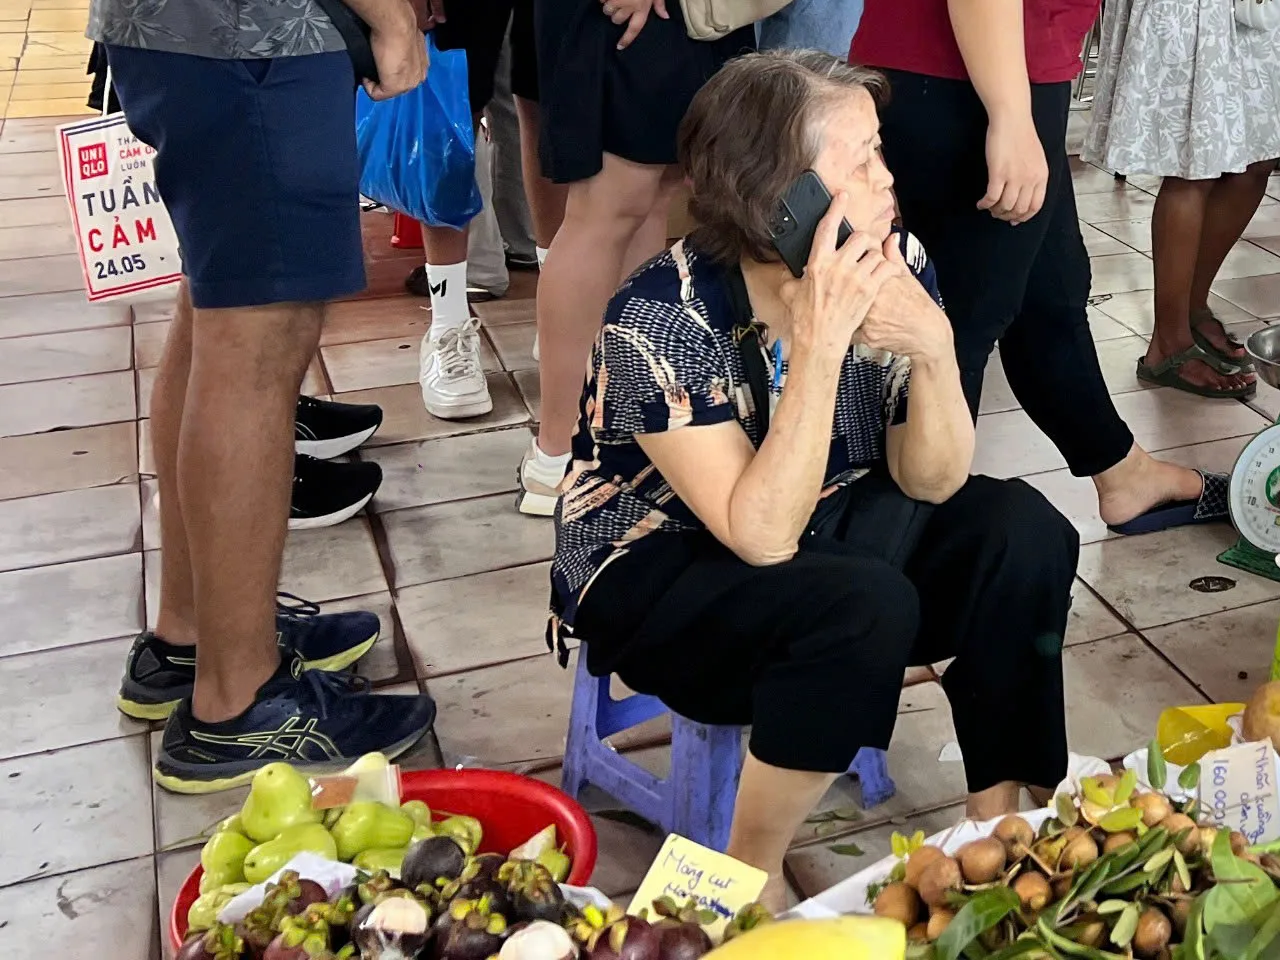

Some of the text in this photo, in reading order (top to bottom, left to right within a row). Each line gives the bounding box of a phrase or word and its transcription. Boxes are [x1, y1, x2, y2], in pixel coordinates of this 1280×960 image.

[81, 146, 103, 161] UNI
[82, 161, 105, 176] QLO
[120, 160, 146, 172] LUÔN
[82, 176, 160, 217] TUẦN
[88, 215, 157, 253] CẢM
[94, 254, 146, 280] 24.05
[1247, 495, 1257, 506] 10
[1256, 745, 1270, 790] Nhãn
